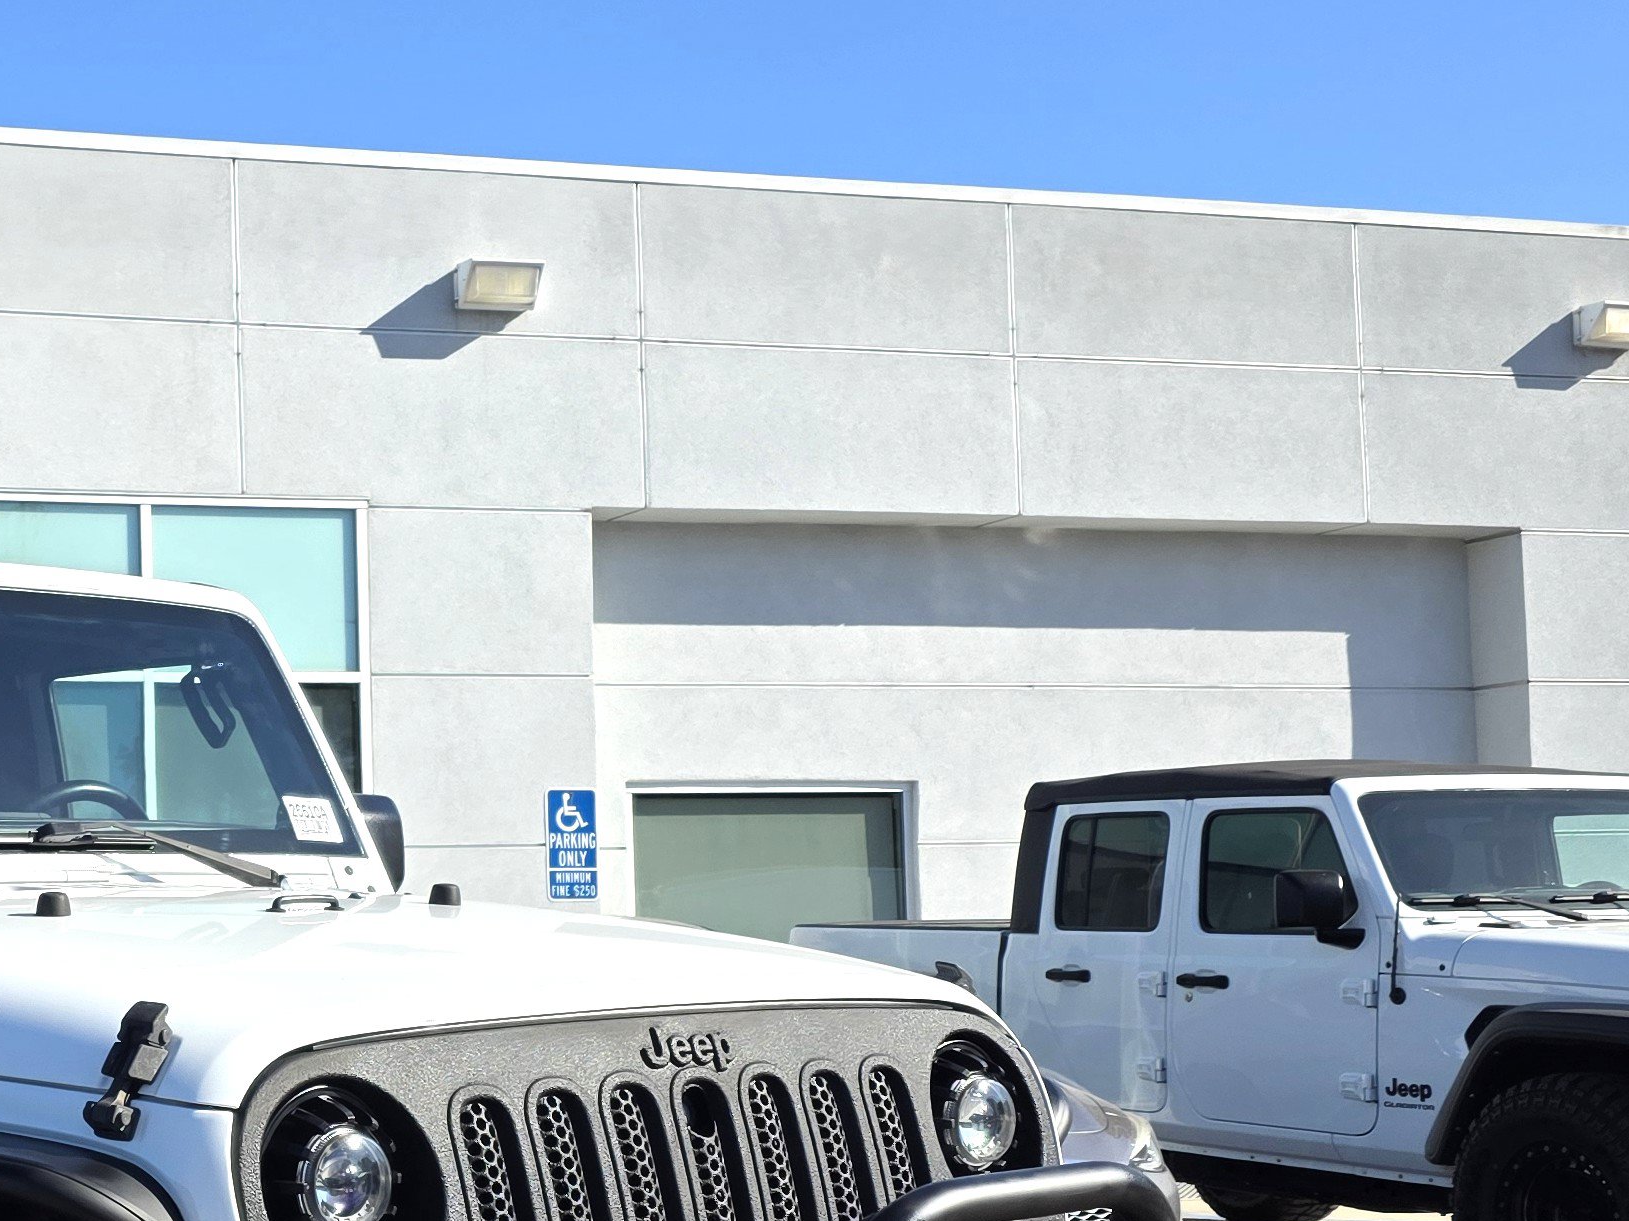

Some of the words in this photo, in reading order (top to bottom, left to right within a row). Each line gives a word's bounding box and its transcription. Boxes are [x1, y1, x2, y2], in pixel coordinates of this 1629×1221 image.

[550, 832, 596, 849] PARKING
[558, 851, 587, 866] ONLY
[556, 872, 591, 883] MINIMUM
[551, 885, 571, 897] FINE
[574, 885, 596, 897] $250
[639, 1026, 737, 1073] Jeep
[1385, 1077, 1433, 1103] Jeep
